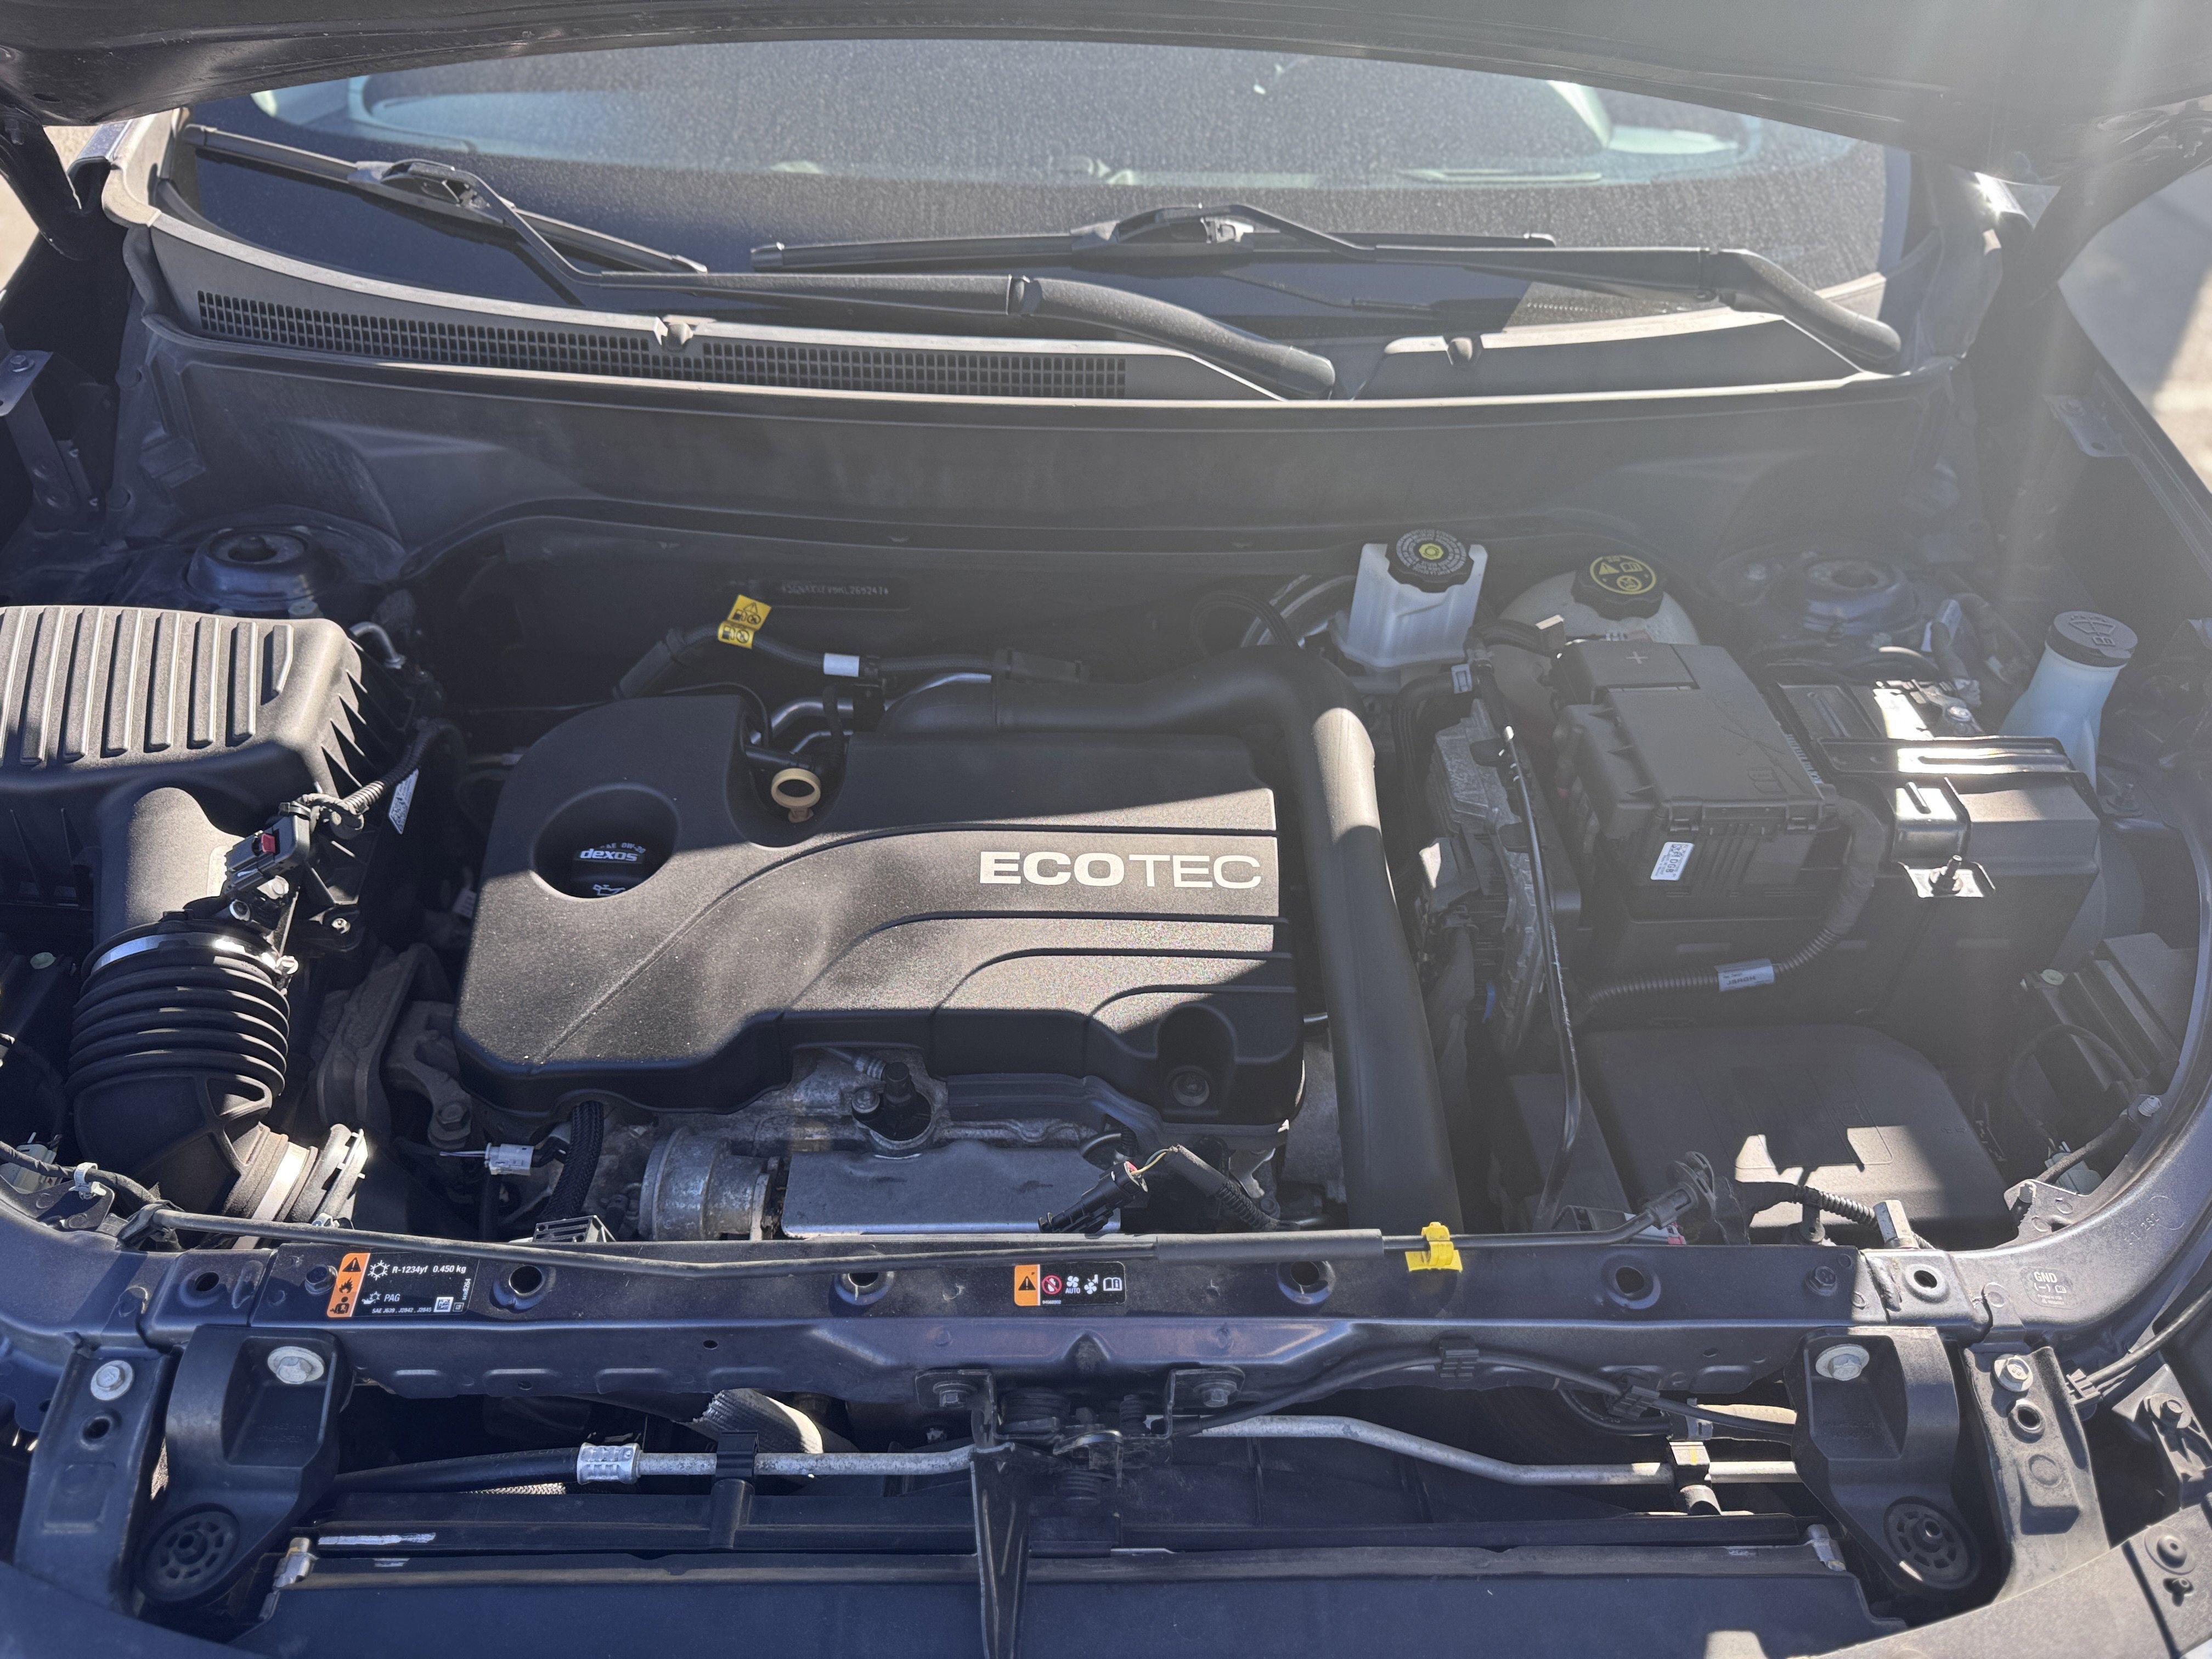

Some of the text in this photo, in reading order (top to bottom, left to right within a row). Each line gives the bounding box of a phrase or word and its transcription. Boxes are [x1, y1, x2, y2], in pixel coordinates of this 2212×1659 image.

[580, 848, 638, 861] dexos
[980, 851, 1261, 889] ECOTEC
[391, 1265, 467, 1274] R-1234yf 0.450 kg
[2033, 1271, 2057, 1283] GND
[383, 1293, 400, 1302] PAG
